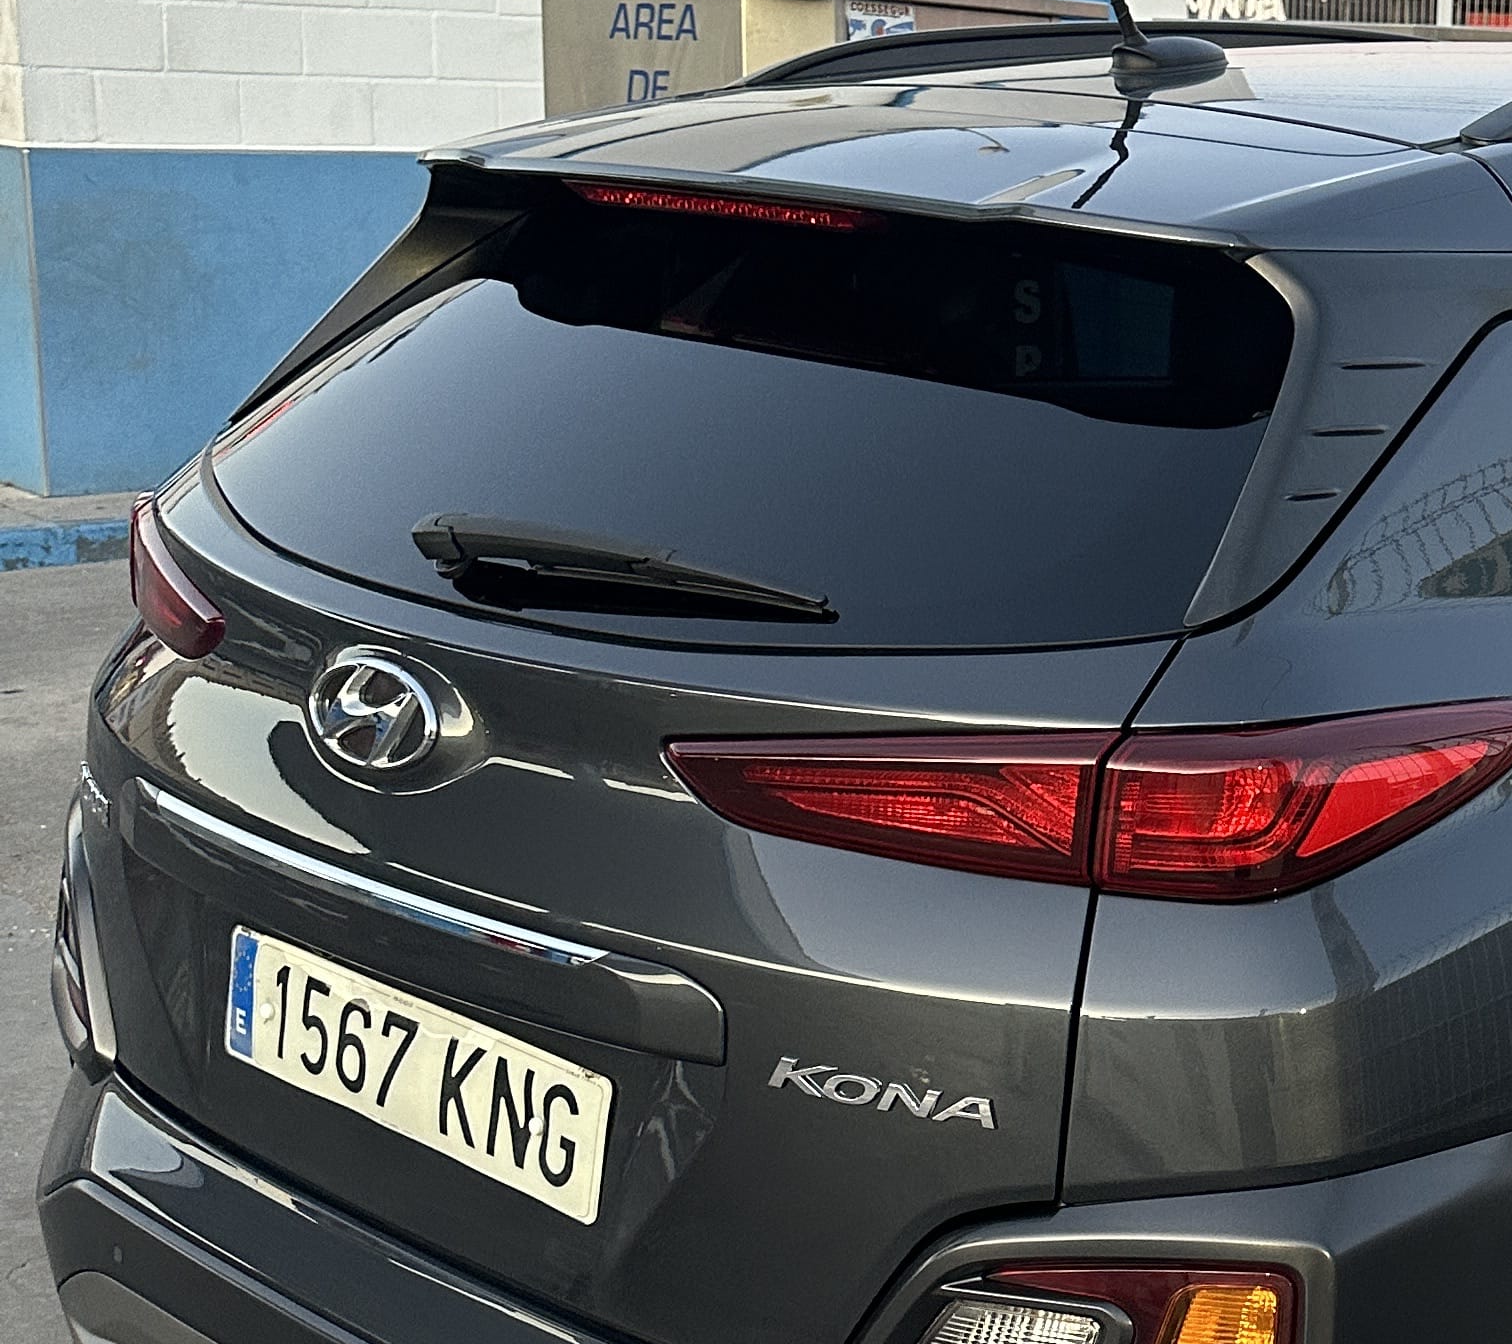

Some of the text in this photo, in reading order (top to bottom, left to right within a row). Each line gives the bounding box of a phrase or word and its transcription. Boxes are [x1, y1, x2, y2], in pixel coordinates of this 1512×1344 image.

[608, 2, 698, 42] AREA
[627, 69, 670, 103] DE
[235, 1007, 247, 1035] E
[276, 964, 580, 1189] 1567 KNG
[767, 1056, 998, 1131] KONA
